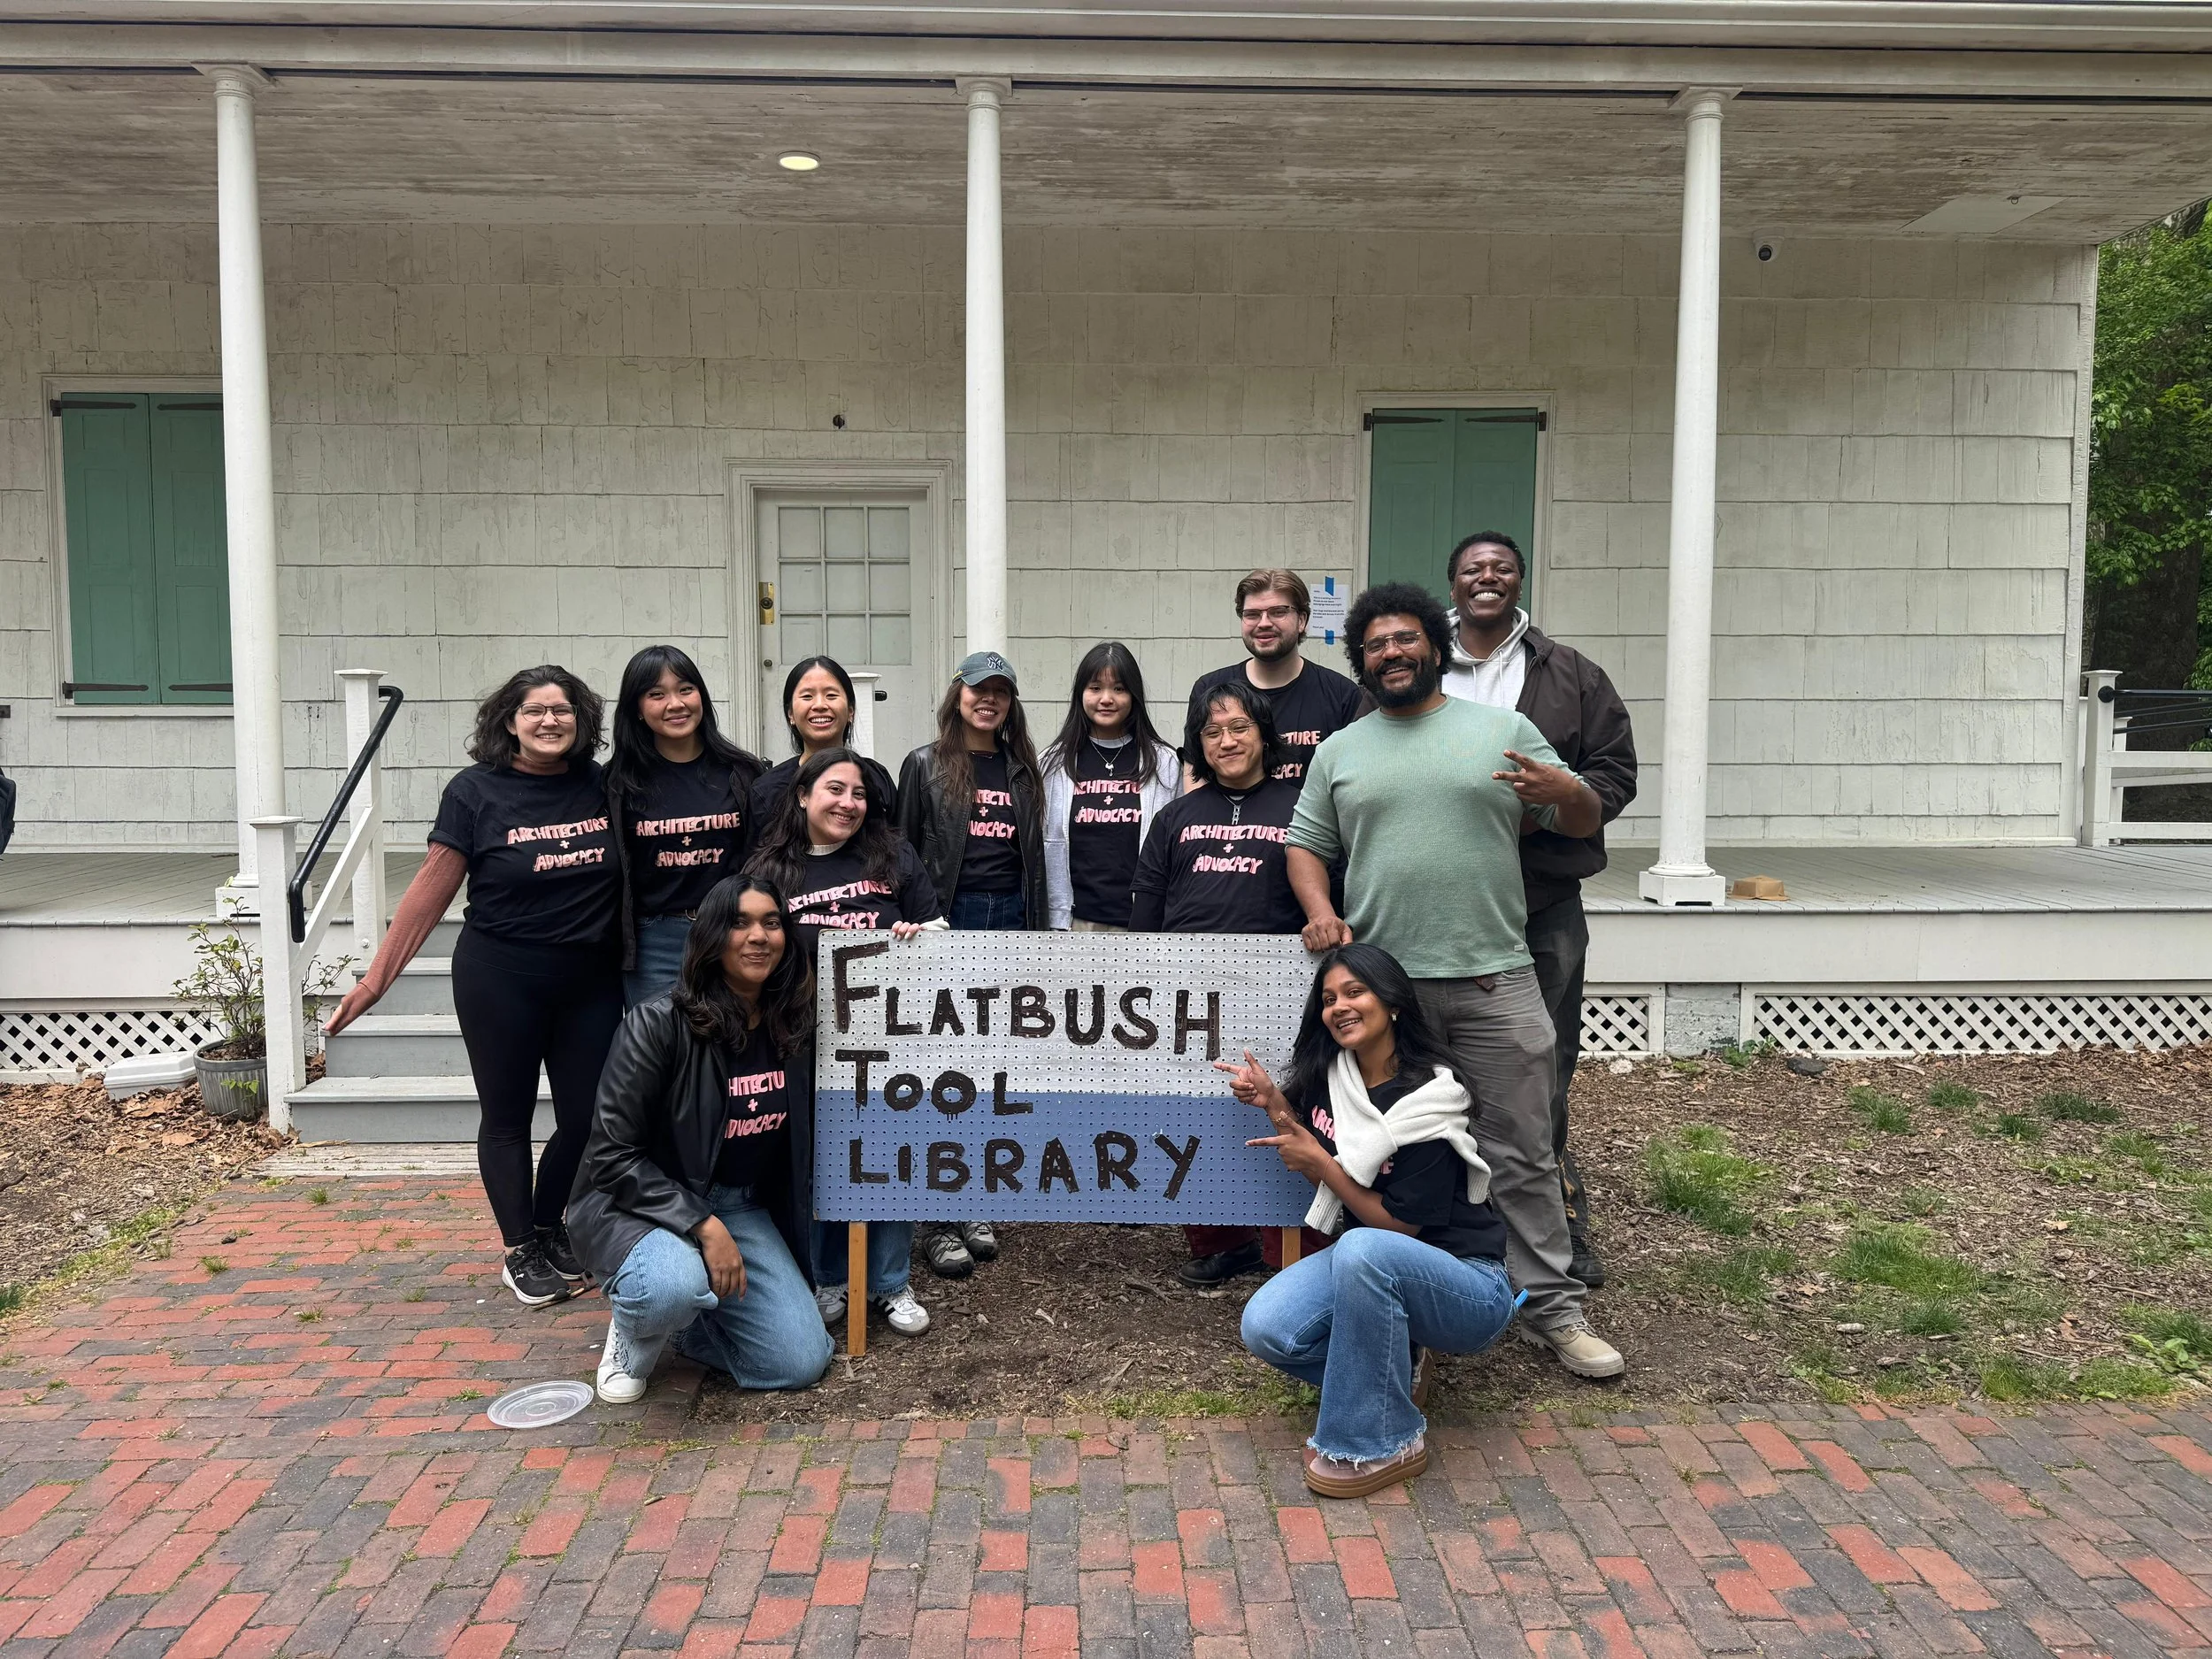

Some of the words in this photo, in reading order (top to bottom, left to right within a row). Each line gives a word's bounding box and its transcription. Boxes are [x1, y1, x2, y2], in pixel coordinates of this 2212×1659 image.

[635, 811, 741, 837] ARCHITECTURE
[1075, 806, 1142, 823] ADVOCACY
[1179, 825, 1288, 844] ARCHITECTURE
[533, 847, 605, 872] ADVOCACY
[656, 848, 724, 867] ADVOCACY
[1192, 853, 1263, 874] ADVOCACY
[832, 940, 1221, 1061] FLATBUSH
[835, 1049, 1033, 1120] TOOL
[849, 1130, 1200, 1201] LIBRARY
